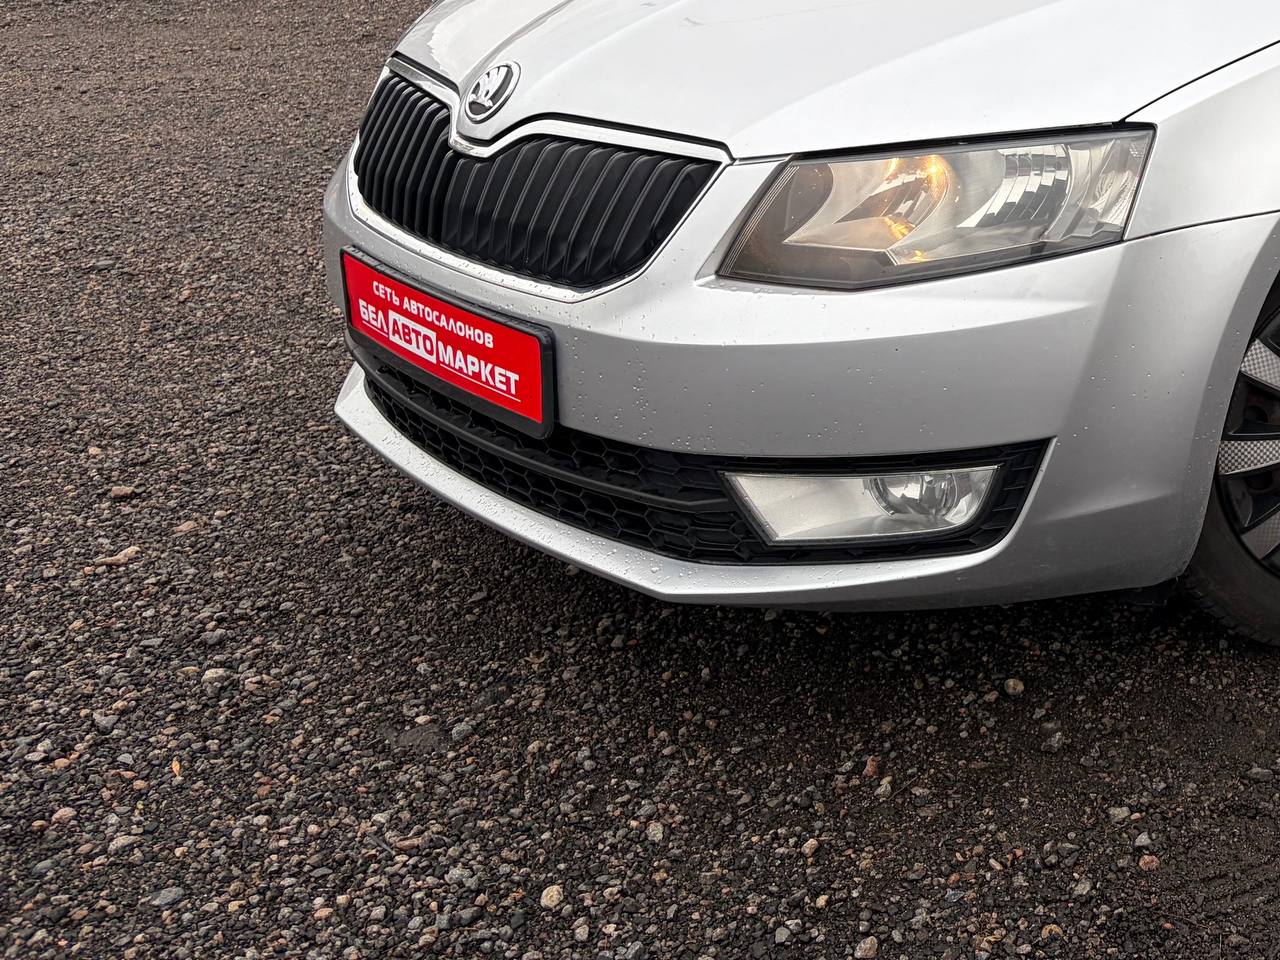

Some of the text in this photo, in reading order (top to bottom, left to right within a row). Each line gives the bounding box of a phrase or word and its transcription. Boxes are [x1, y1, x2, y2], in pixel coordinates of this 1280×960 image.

[359, 299, 520, 395] БЕЛ АВТО МАРКЕТ
[373, 281, 494, 348] СЕТЬ АВТОСАЛОНОВ
